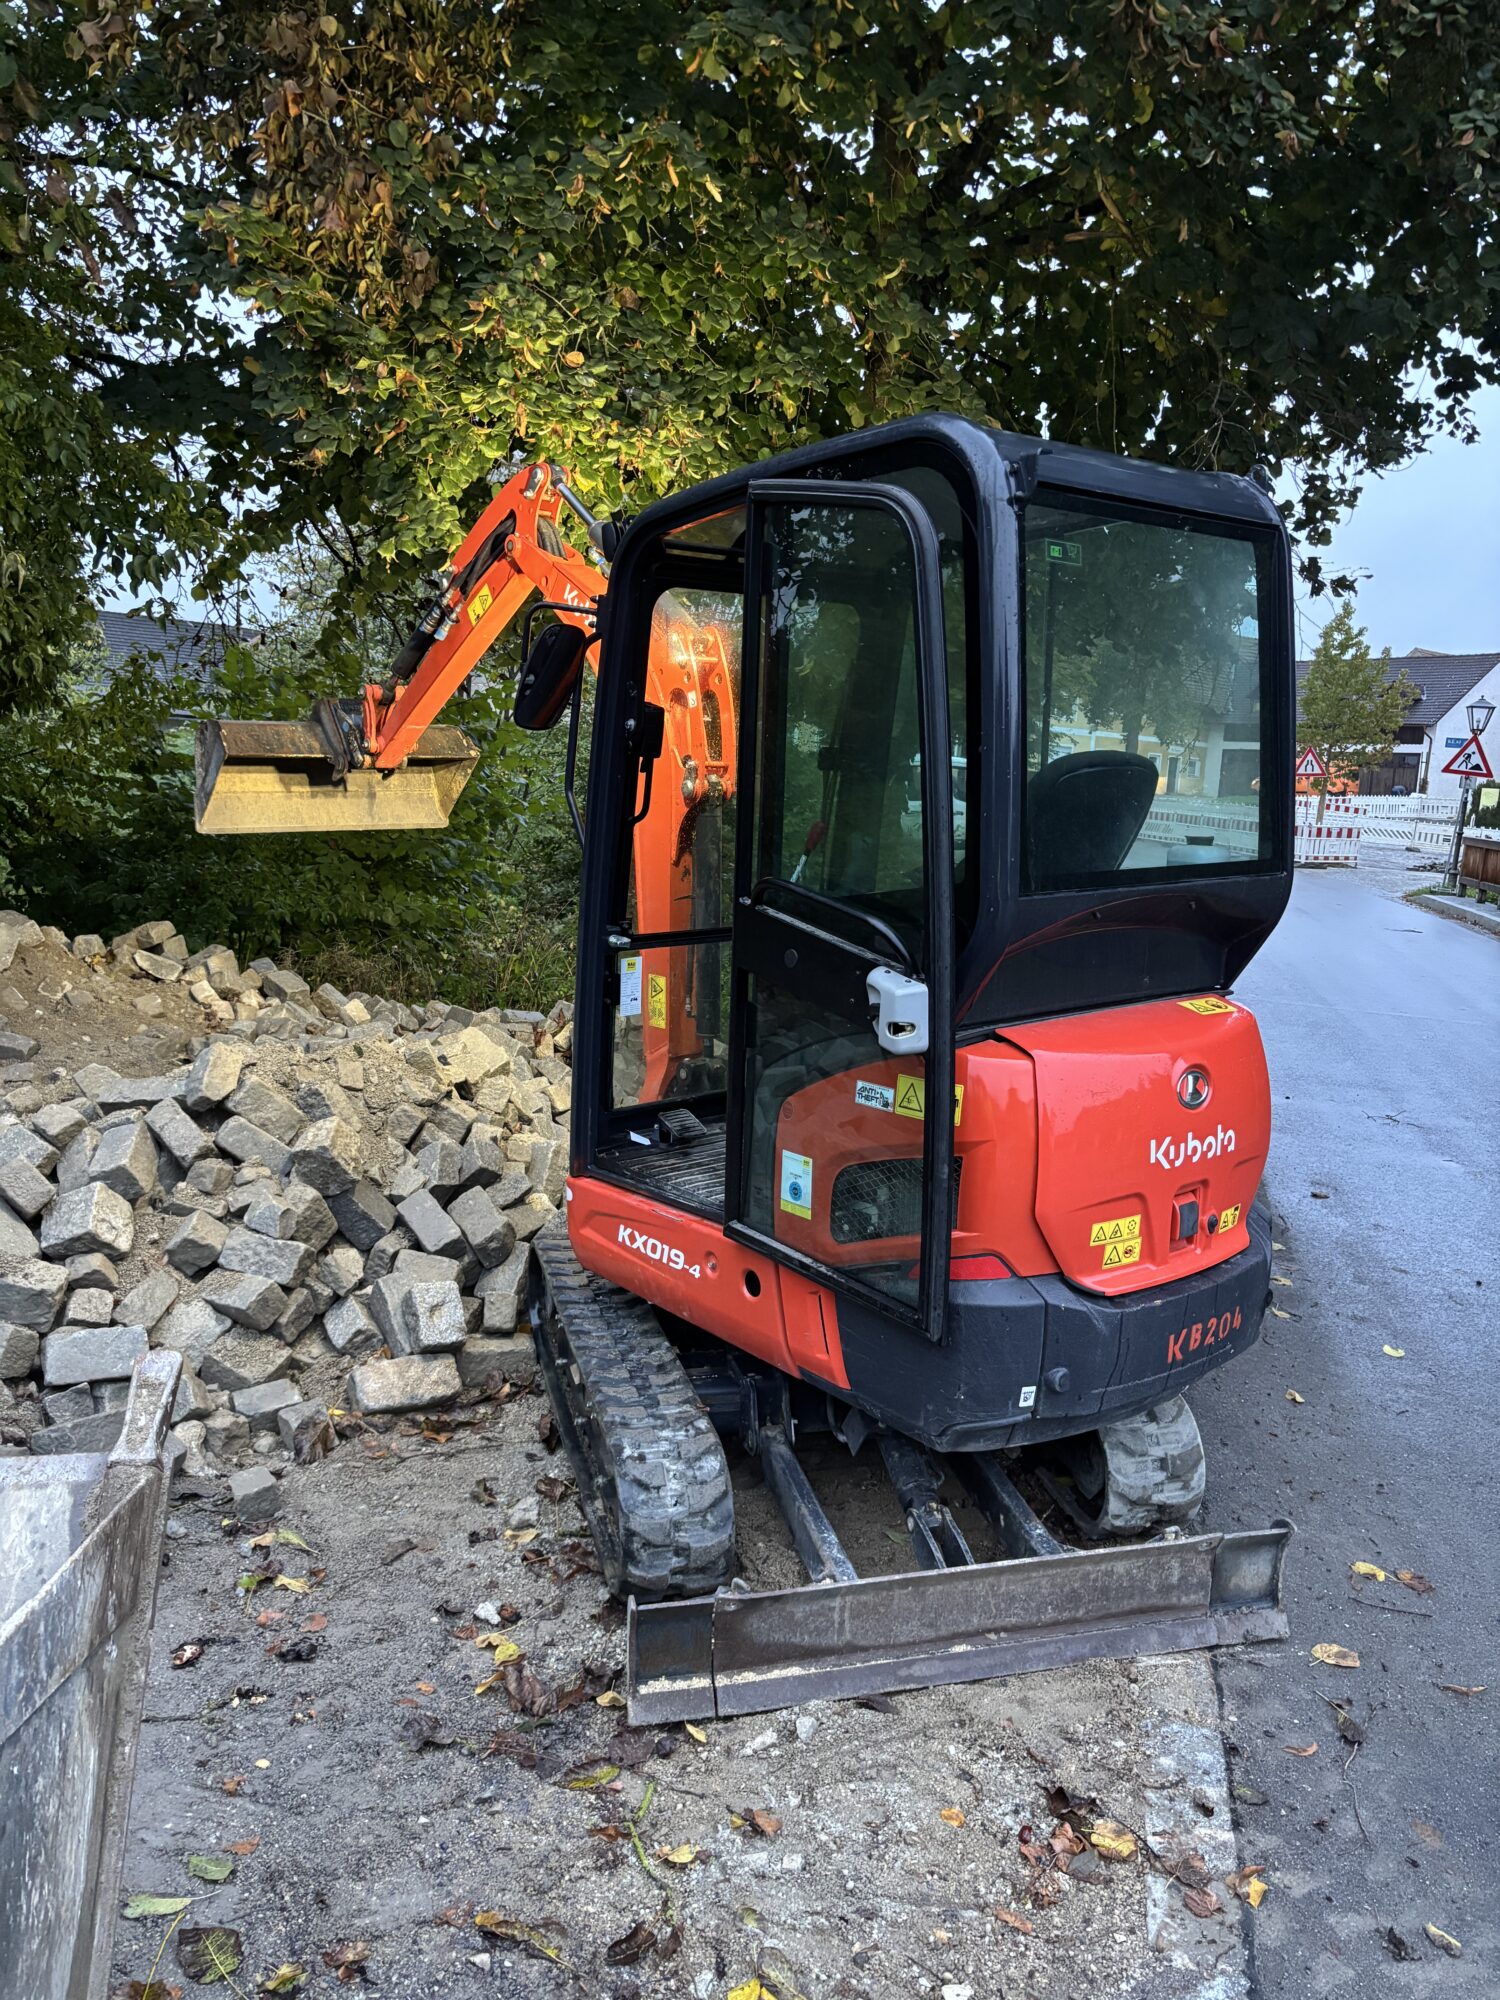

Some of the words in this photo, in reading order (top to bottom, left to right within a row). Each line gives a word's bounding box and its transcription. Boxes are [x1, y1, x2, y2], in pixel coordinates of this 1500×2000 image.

[857, 1092, 880, 1103] THEFT
[1150, 1124, 1235, 1169] Kubota
[618, 1224, 700, 1278] KX019-4
[1168, 1306, 1241, 1364] KB204
